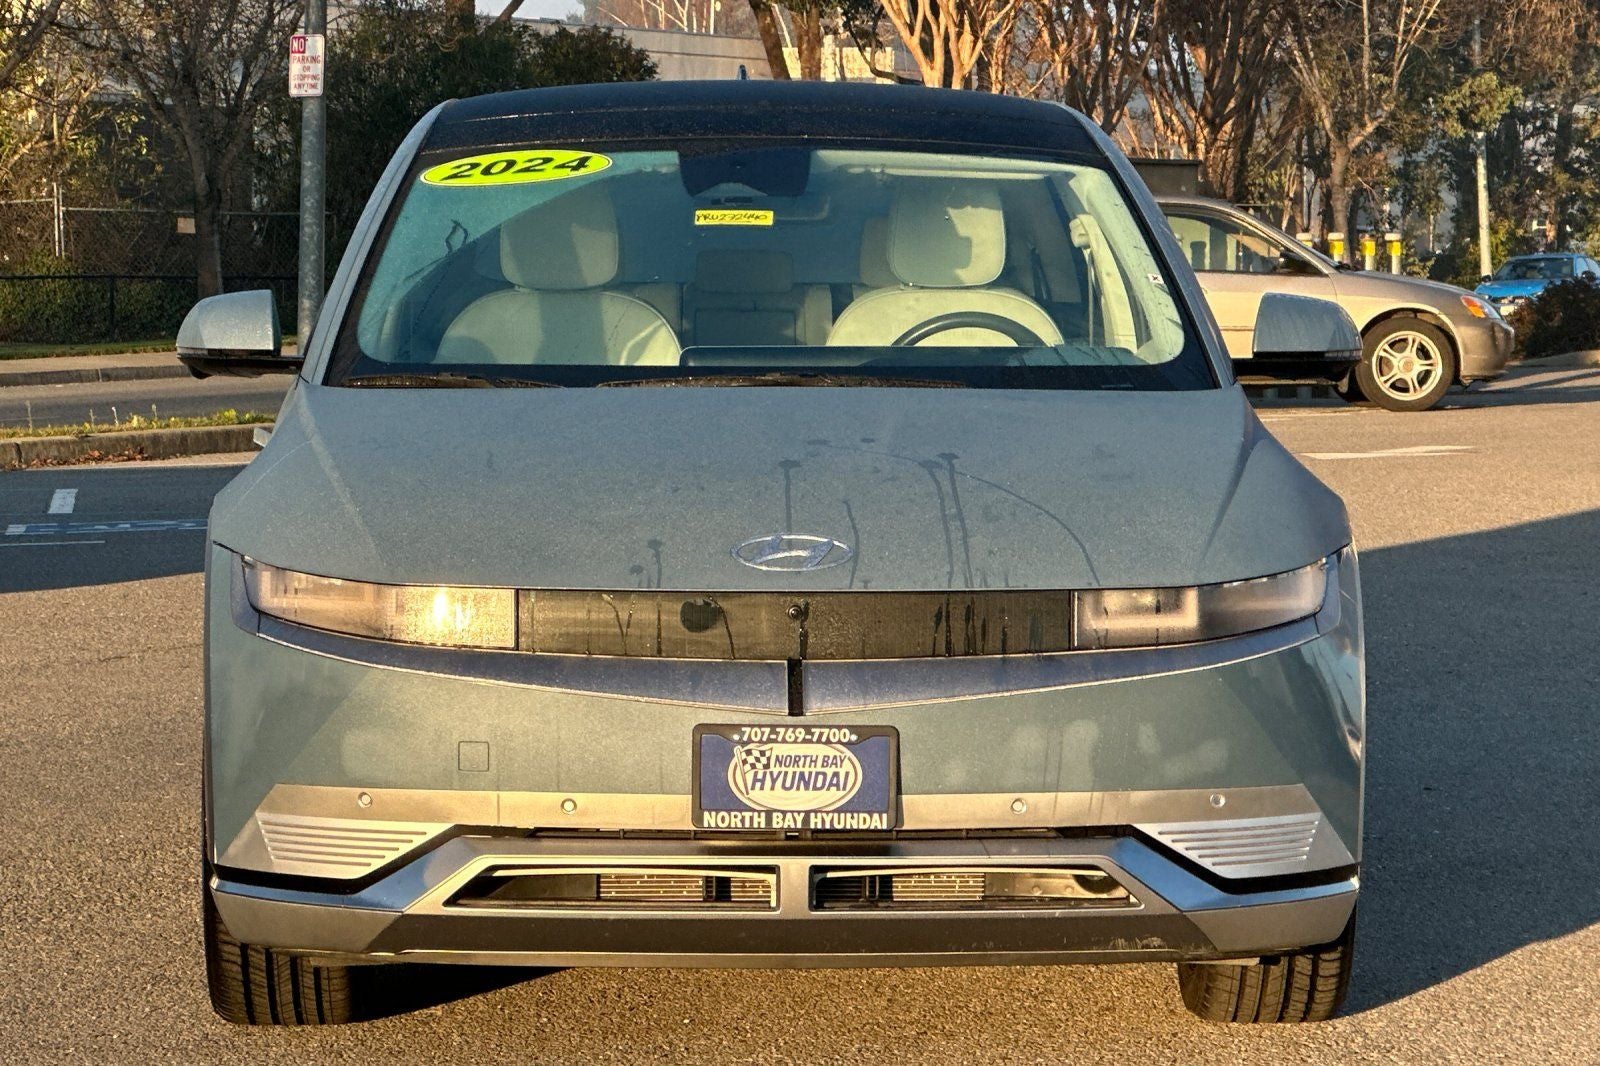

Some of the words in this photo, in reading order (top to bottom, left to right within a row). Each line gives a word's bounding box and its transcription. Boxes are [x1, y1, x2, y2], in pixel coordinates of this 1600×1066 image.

[292, 38, 305, 52] NO
[293, 55, 320, 64] PARKING
[303, 65, 311, 73] OR
[440, 156, 593, 181] 2024
[741, 728, 850, 742] 707-769-7700
[774, 755, 818, 768] NORTH
[821, 755, 847, 768] BAY
[751, 771, 850, 791] HYUNDAI
[703, 811, 766, 828] NORTH
[772, 812, 805, 829] BAY
[810, 813, 887, 829] HYUNDAI
